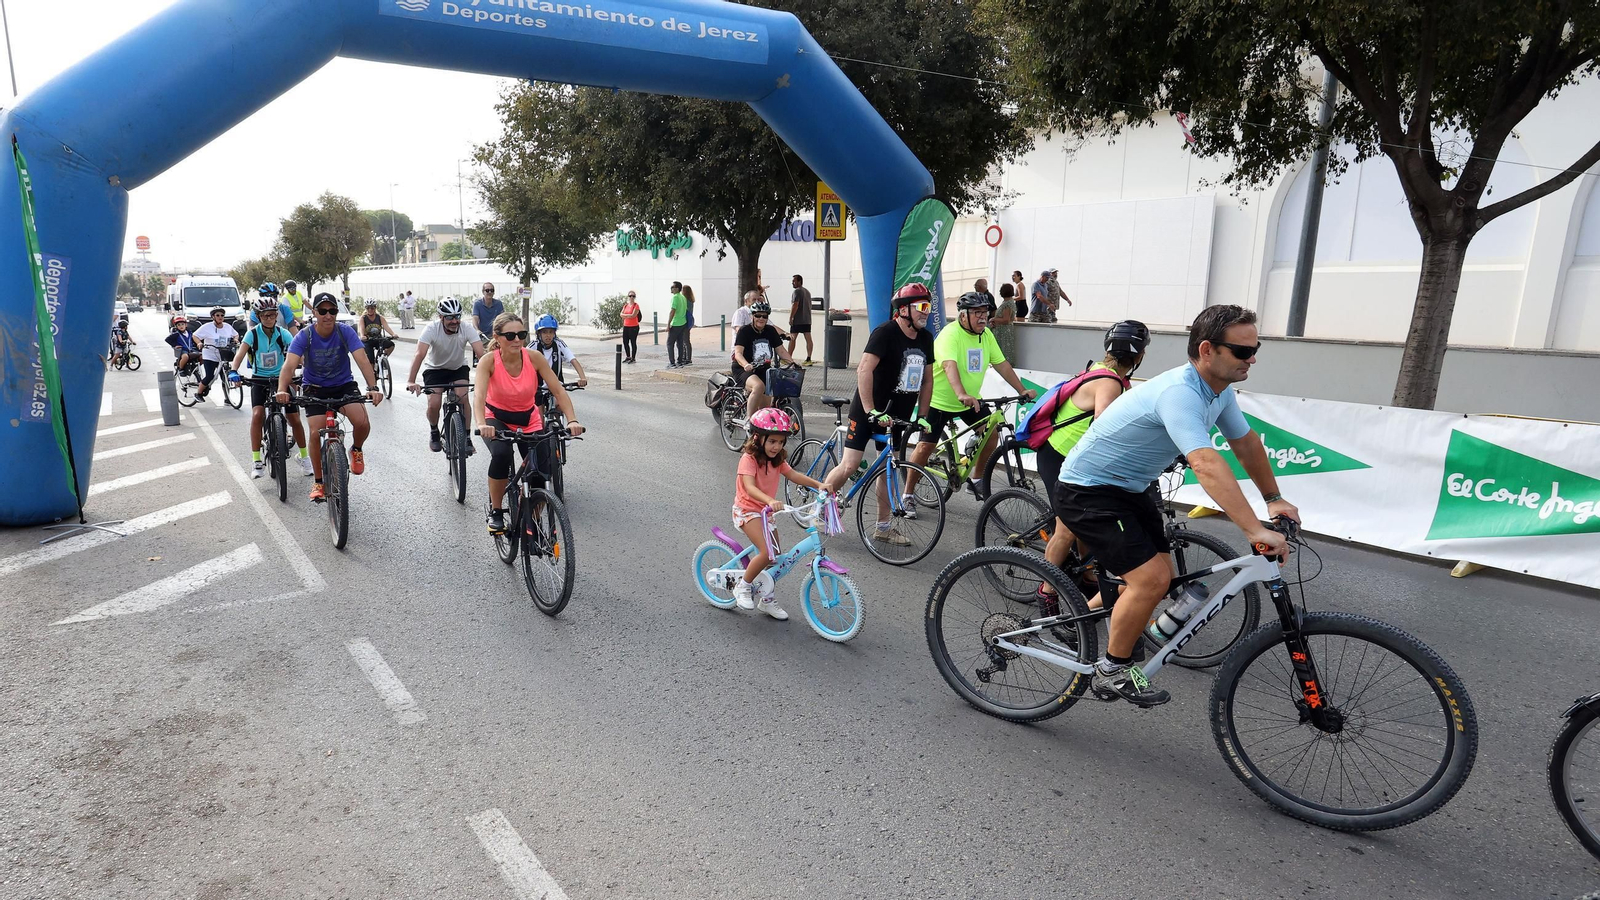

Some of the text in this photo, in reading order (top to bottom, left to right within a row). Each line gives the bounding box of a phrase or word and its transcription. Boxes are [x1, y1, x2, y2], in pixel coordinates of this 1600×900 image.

[442, 2, 548, 29] Deportes
[661, 17, 692, 33] de
[697, 22, 759, 43] Jerez
[820, 229, 842, 237] PEATONES
[1447, 472, 1473, 498] El
[1474, 478, 1541, 509] Corte
[1292, 651, 1306, 661] 34
[1434, 676, 1464, 732] MAXXIS
